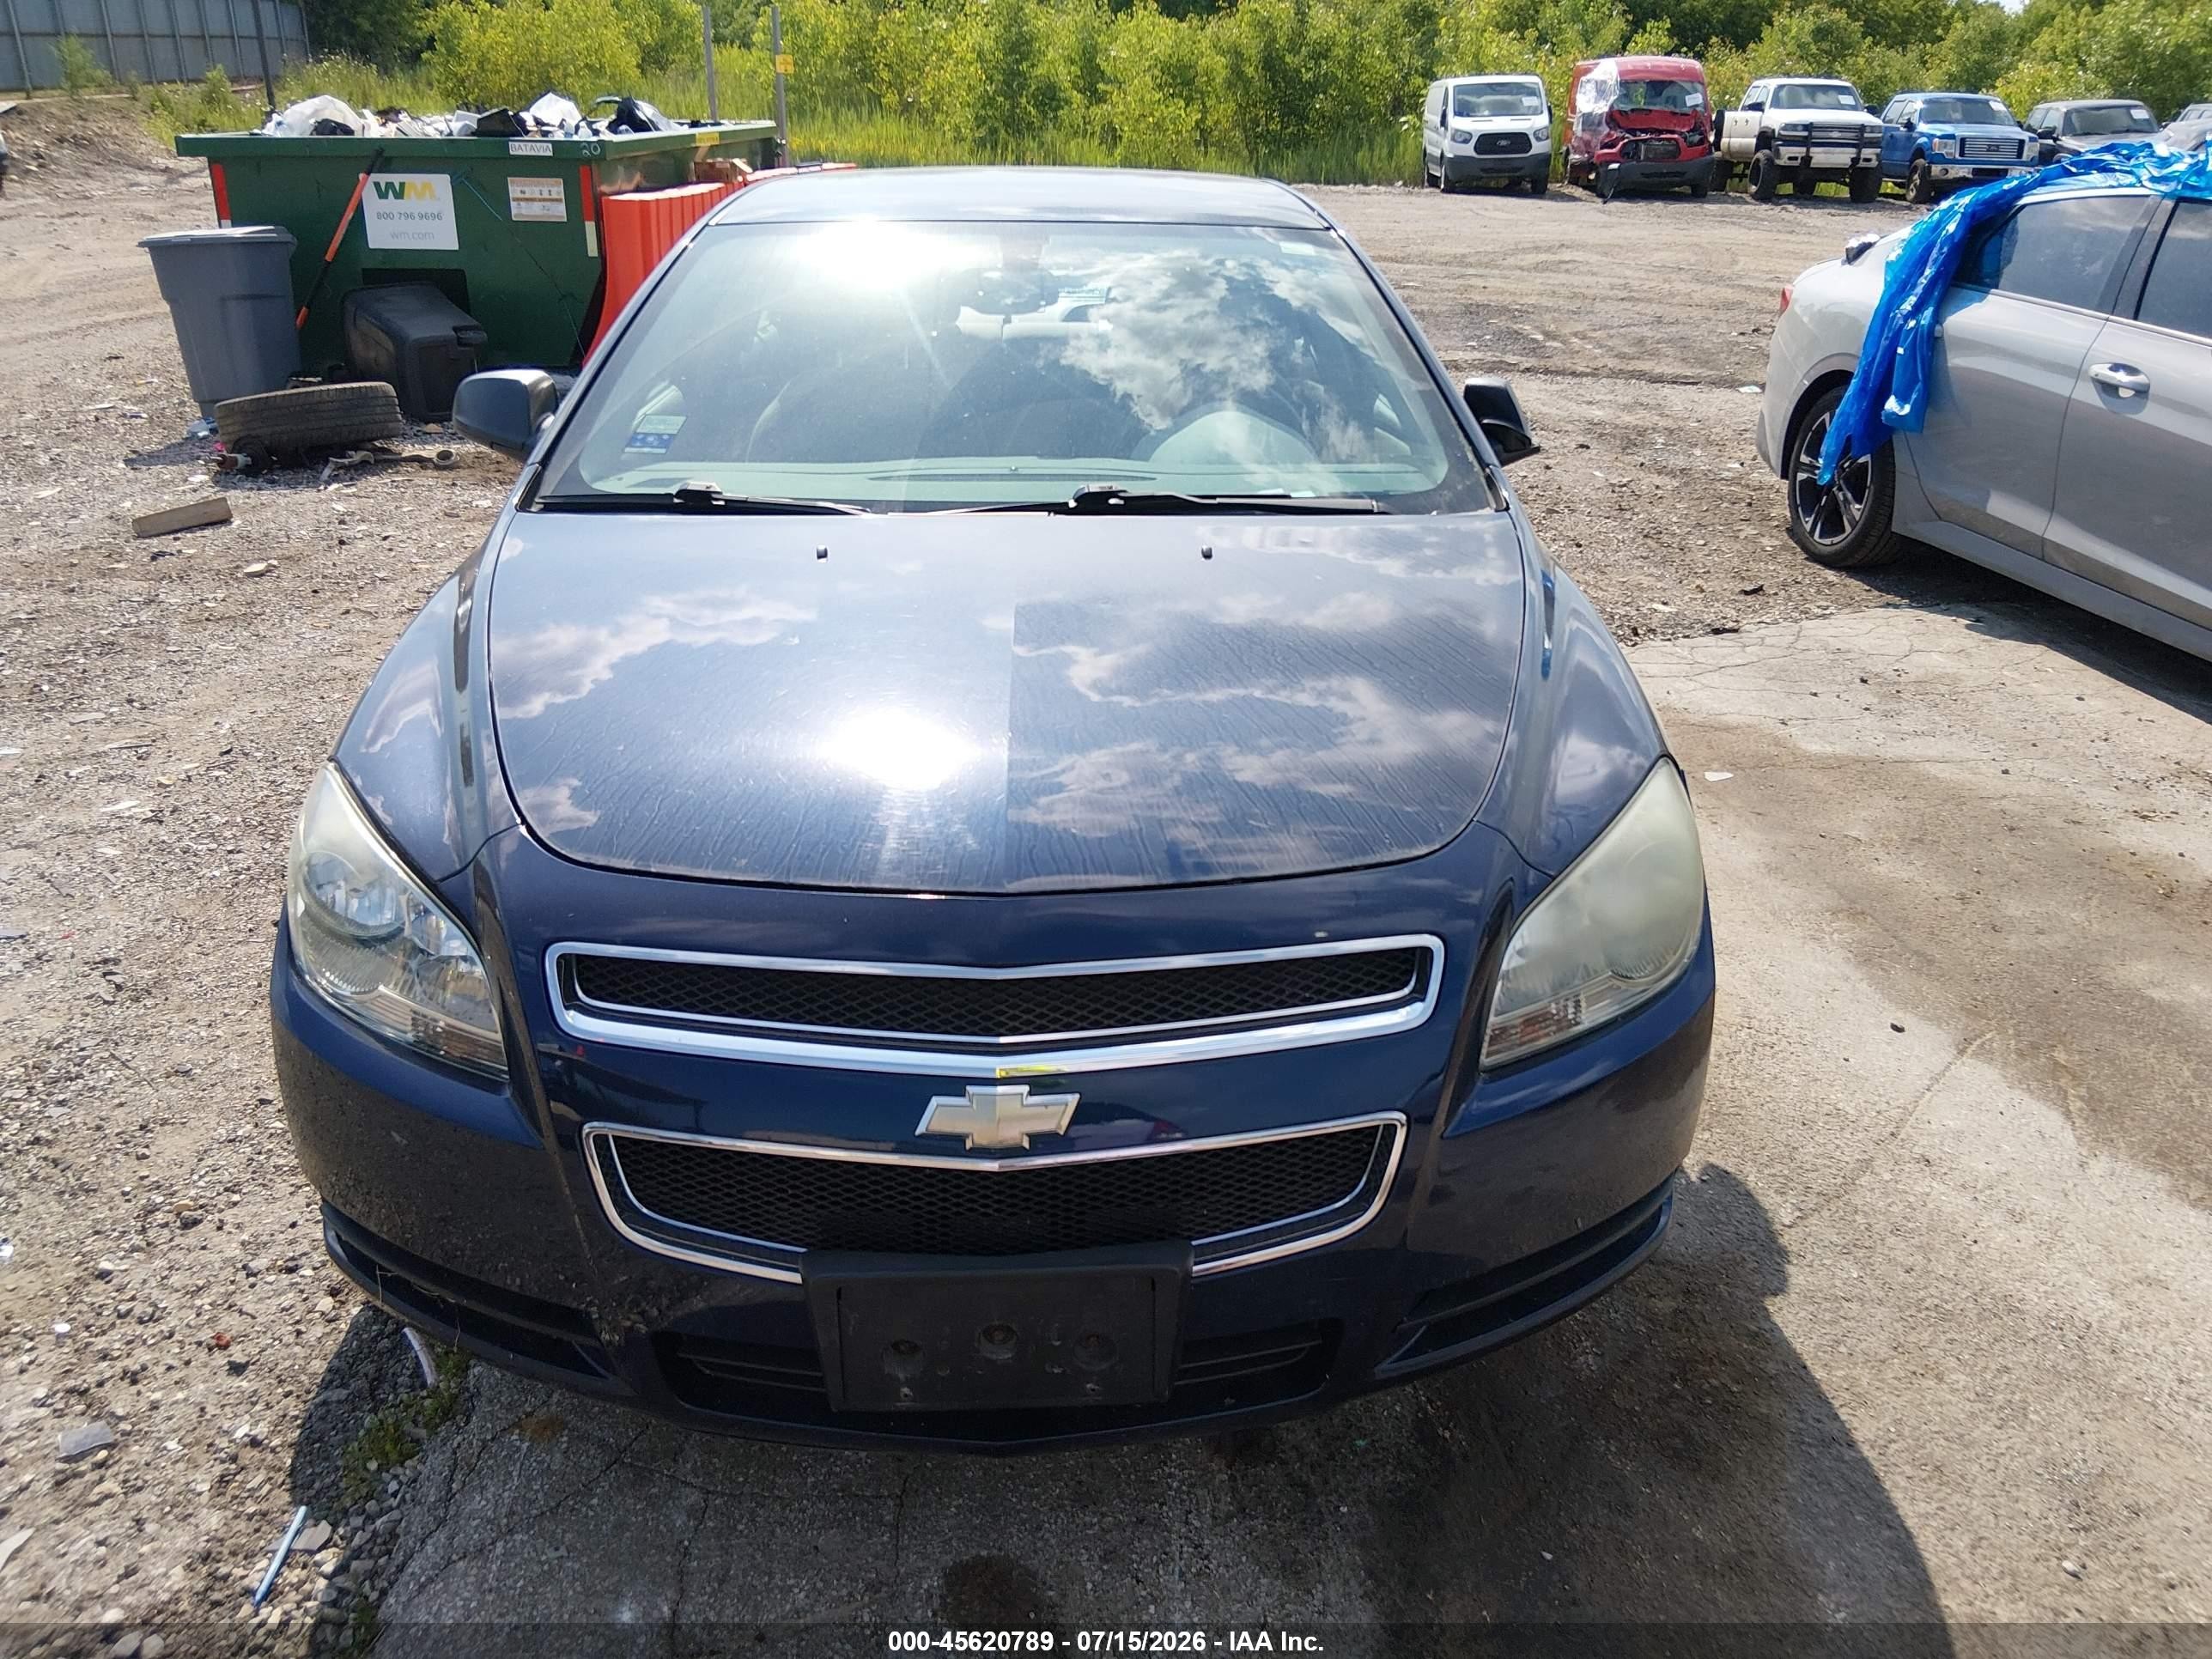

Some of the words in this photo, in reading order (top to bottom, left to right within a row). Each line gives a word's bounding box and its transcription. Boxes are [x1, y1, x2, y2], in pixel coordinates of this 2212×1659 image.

[510, 143, 552, 153] BATAVIA
[373, 180, 437, 200] WM
[376, 211, 395, 221] 800
[398, 211, 416, 221] 796
[418, 211, 443, 221] 9696
[391, 231, 434, 240] wm.com
